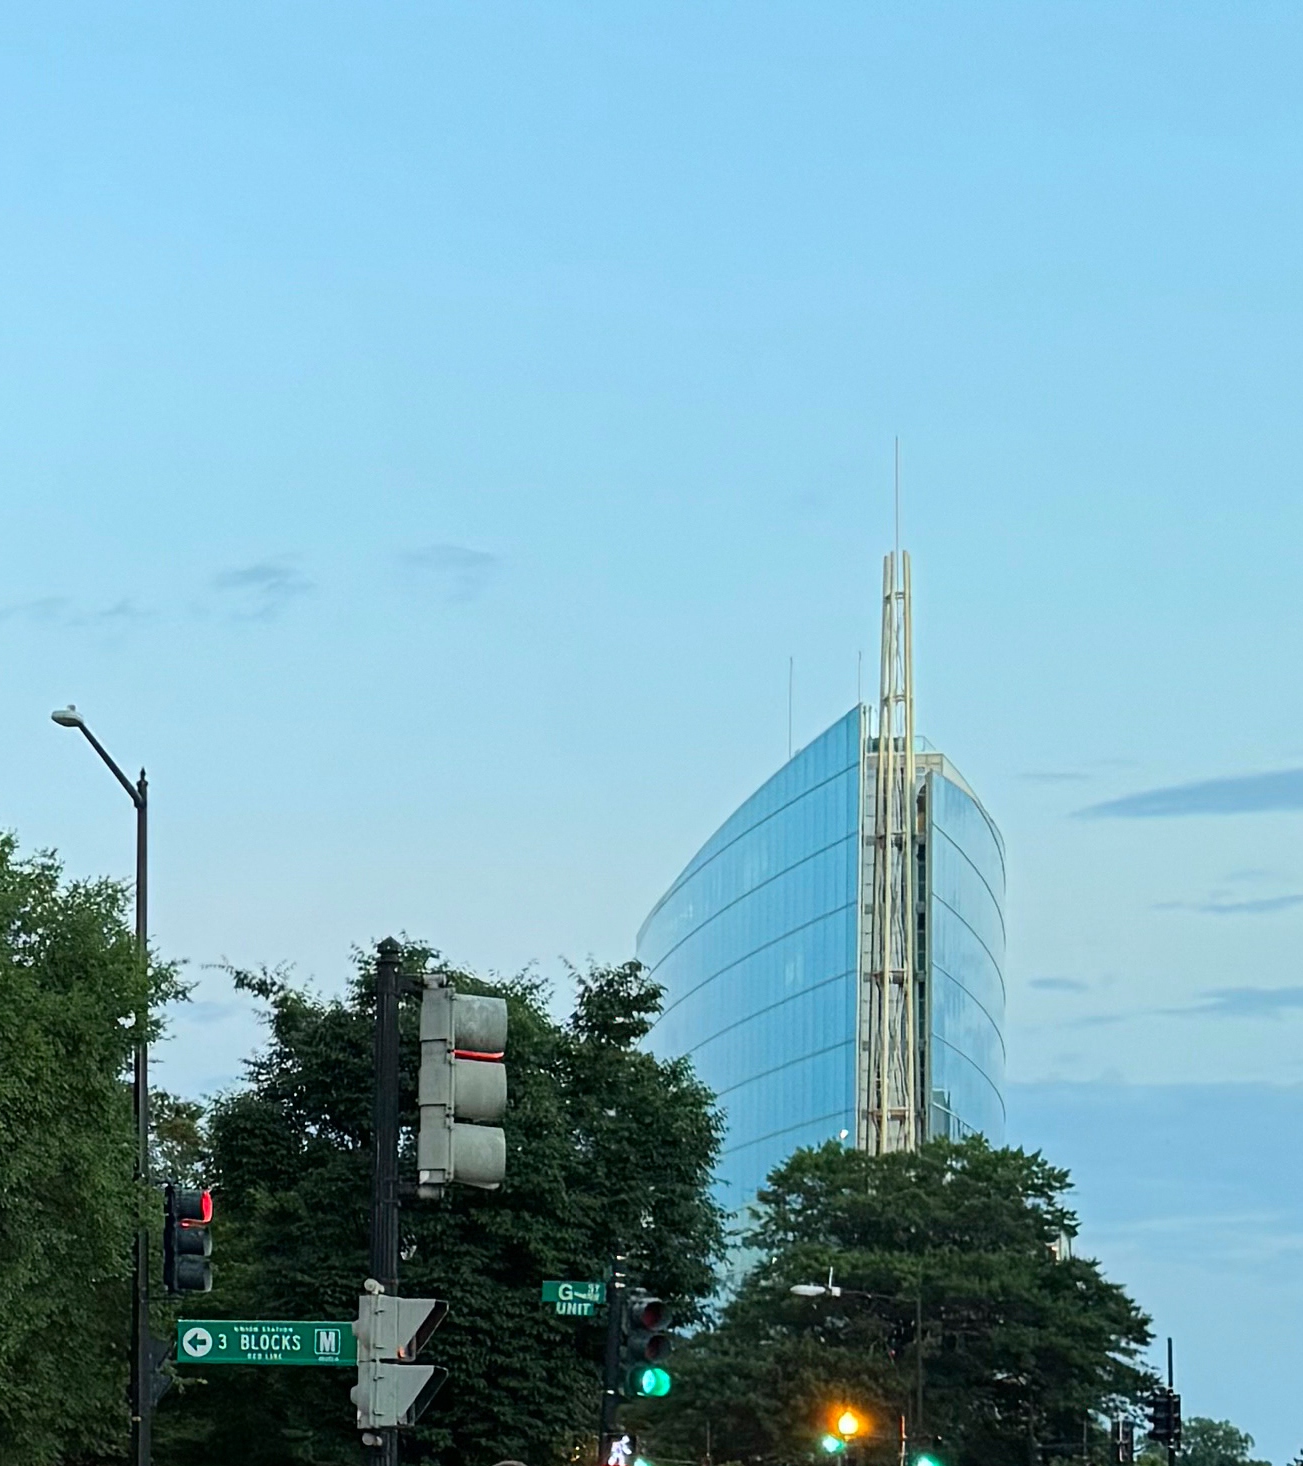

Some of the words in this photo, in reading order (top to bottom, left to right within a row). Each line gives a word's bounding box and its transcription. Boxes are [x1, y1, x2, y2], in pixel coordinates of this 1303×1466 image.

[558, 1283, 573, 1300] G
[556, 1302, 592, 1315] UNIT
[218, 1334, 227, 1350] 3
[240, 1334, 301, 1350] BLOCKS
